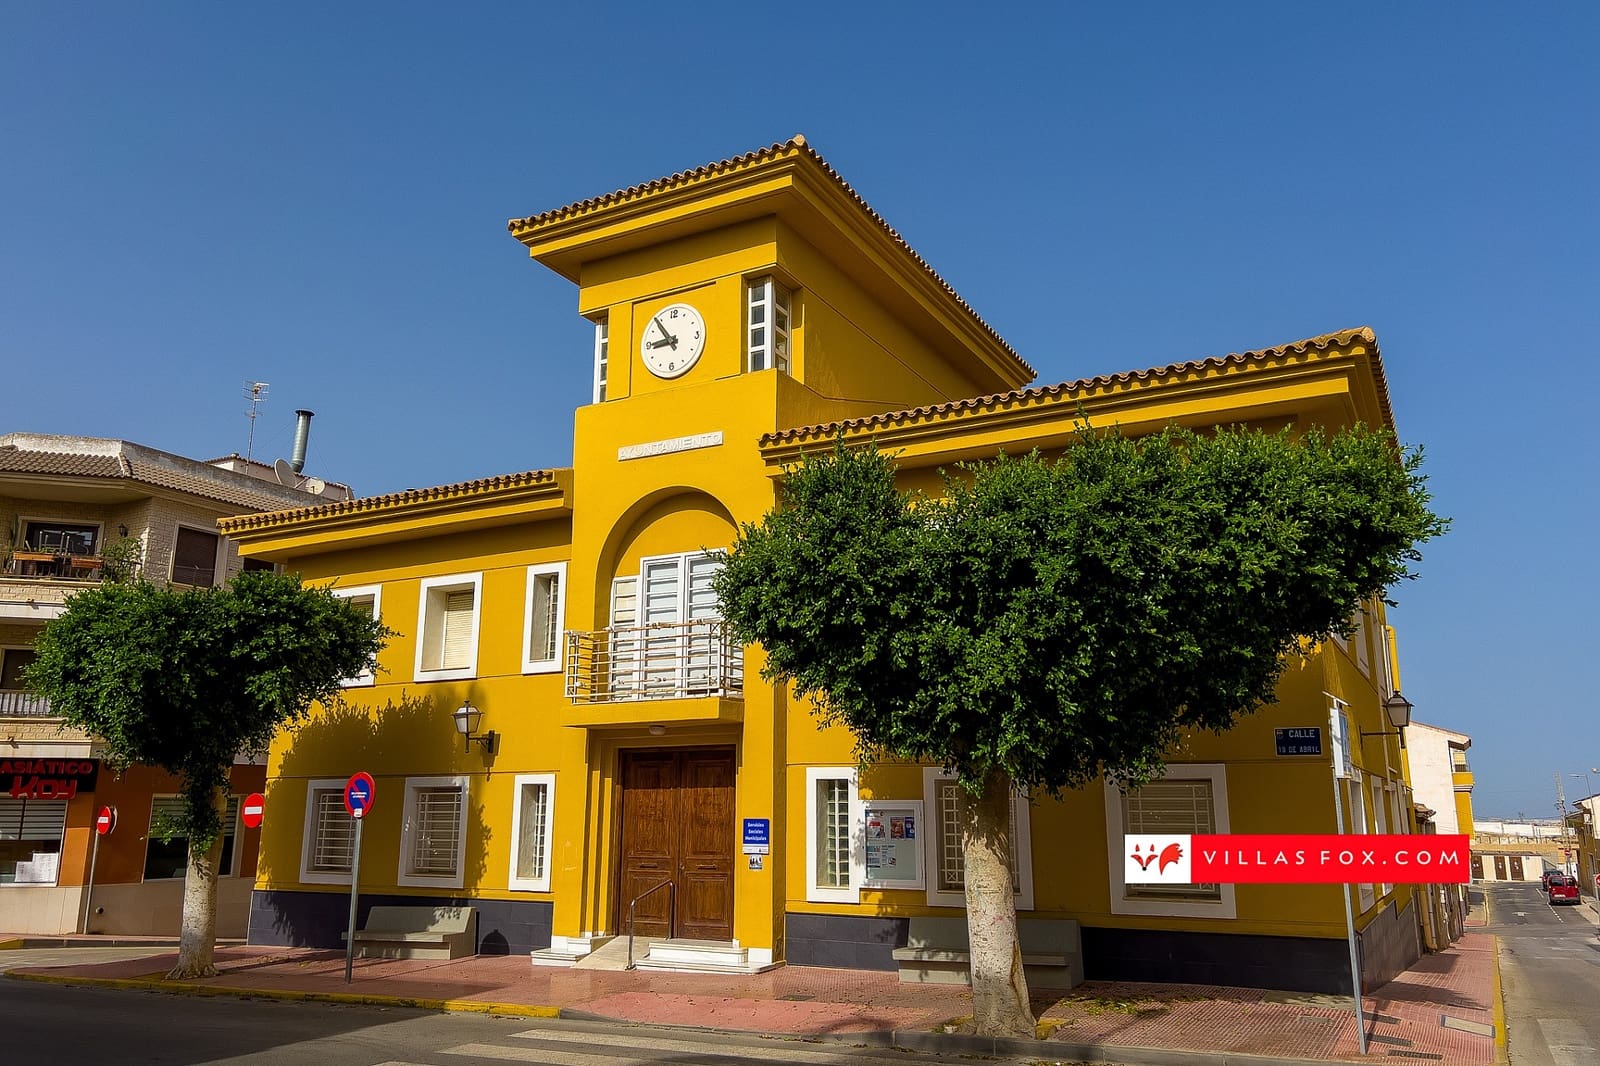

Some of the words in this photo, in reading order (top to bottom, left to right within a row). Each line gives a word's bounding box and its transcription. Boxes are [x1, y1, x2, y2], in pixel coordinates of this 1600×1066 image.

[670, 309, 678, 319] 12
[694, 331, 700, 340] 3
[646, 341, 652, 350] 9
[668, 362, 675, 371] 6
[619, 433, 722, 459] AYUNTAMIENTO
[1288, 729, 1316, 738] CALLE
[1288, 745, 1297, 753] DE
[1299, 745, 1320, 753] ABRIL
[1, 759, 93, 775] ASIÁTICO
